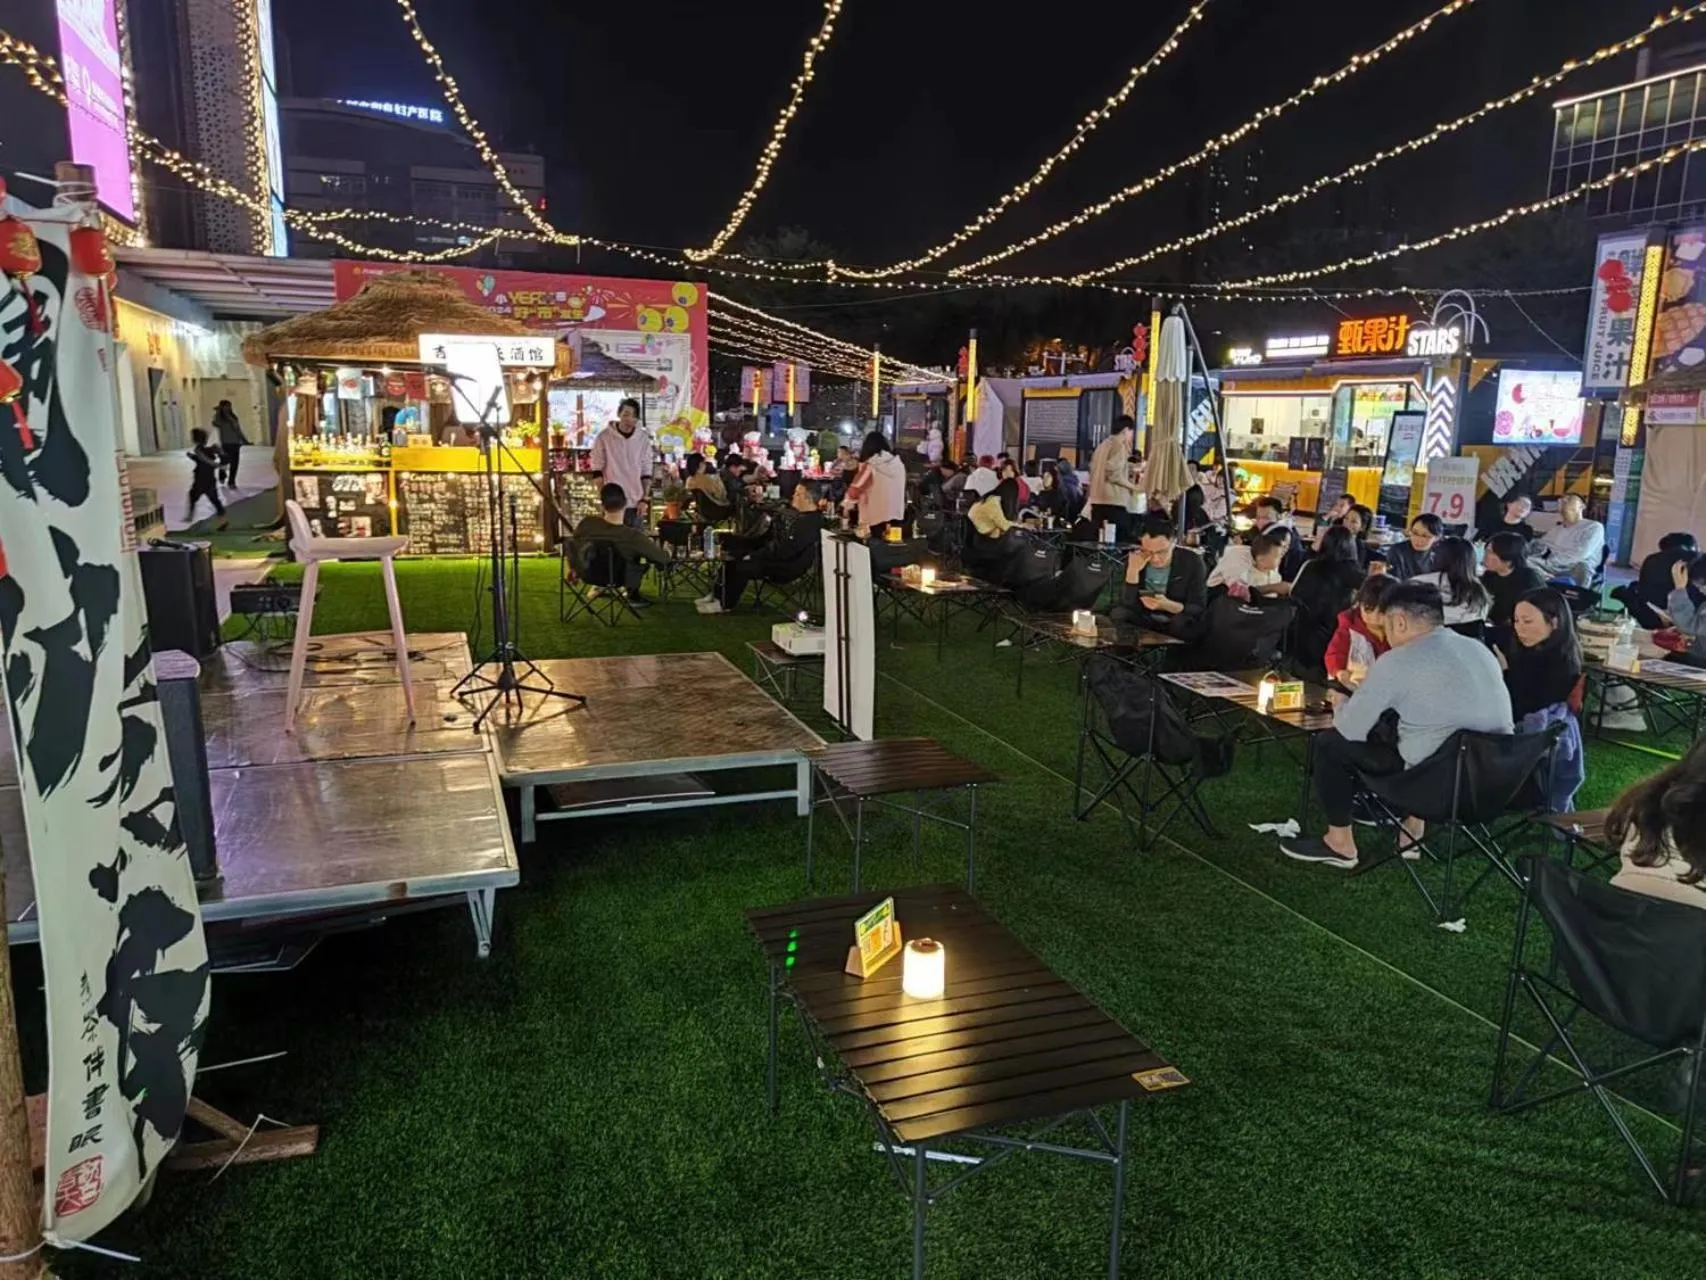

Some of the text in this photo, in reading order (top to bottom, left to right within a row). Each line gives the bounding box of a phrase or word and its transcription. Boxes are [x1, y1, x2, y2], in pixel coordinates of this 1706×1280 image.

[1337, 314, 1410, 355] 甄果汁
[1408, 327, 1460, 357] STARS
[1591, 341, 1604, 381] JUICE
[1428, 492, 1465, 519] 7.9
